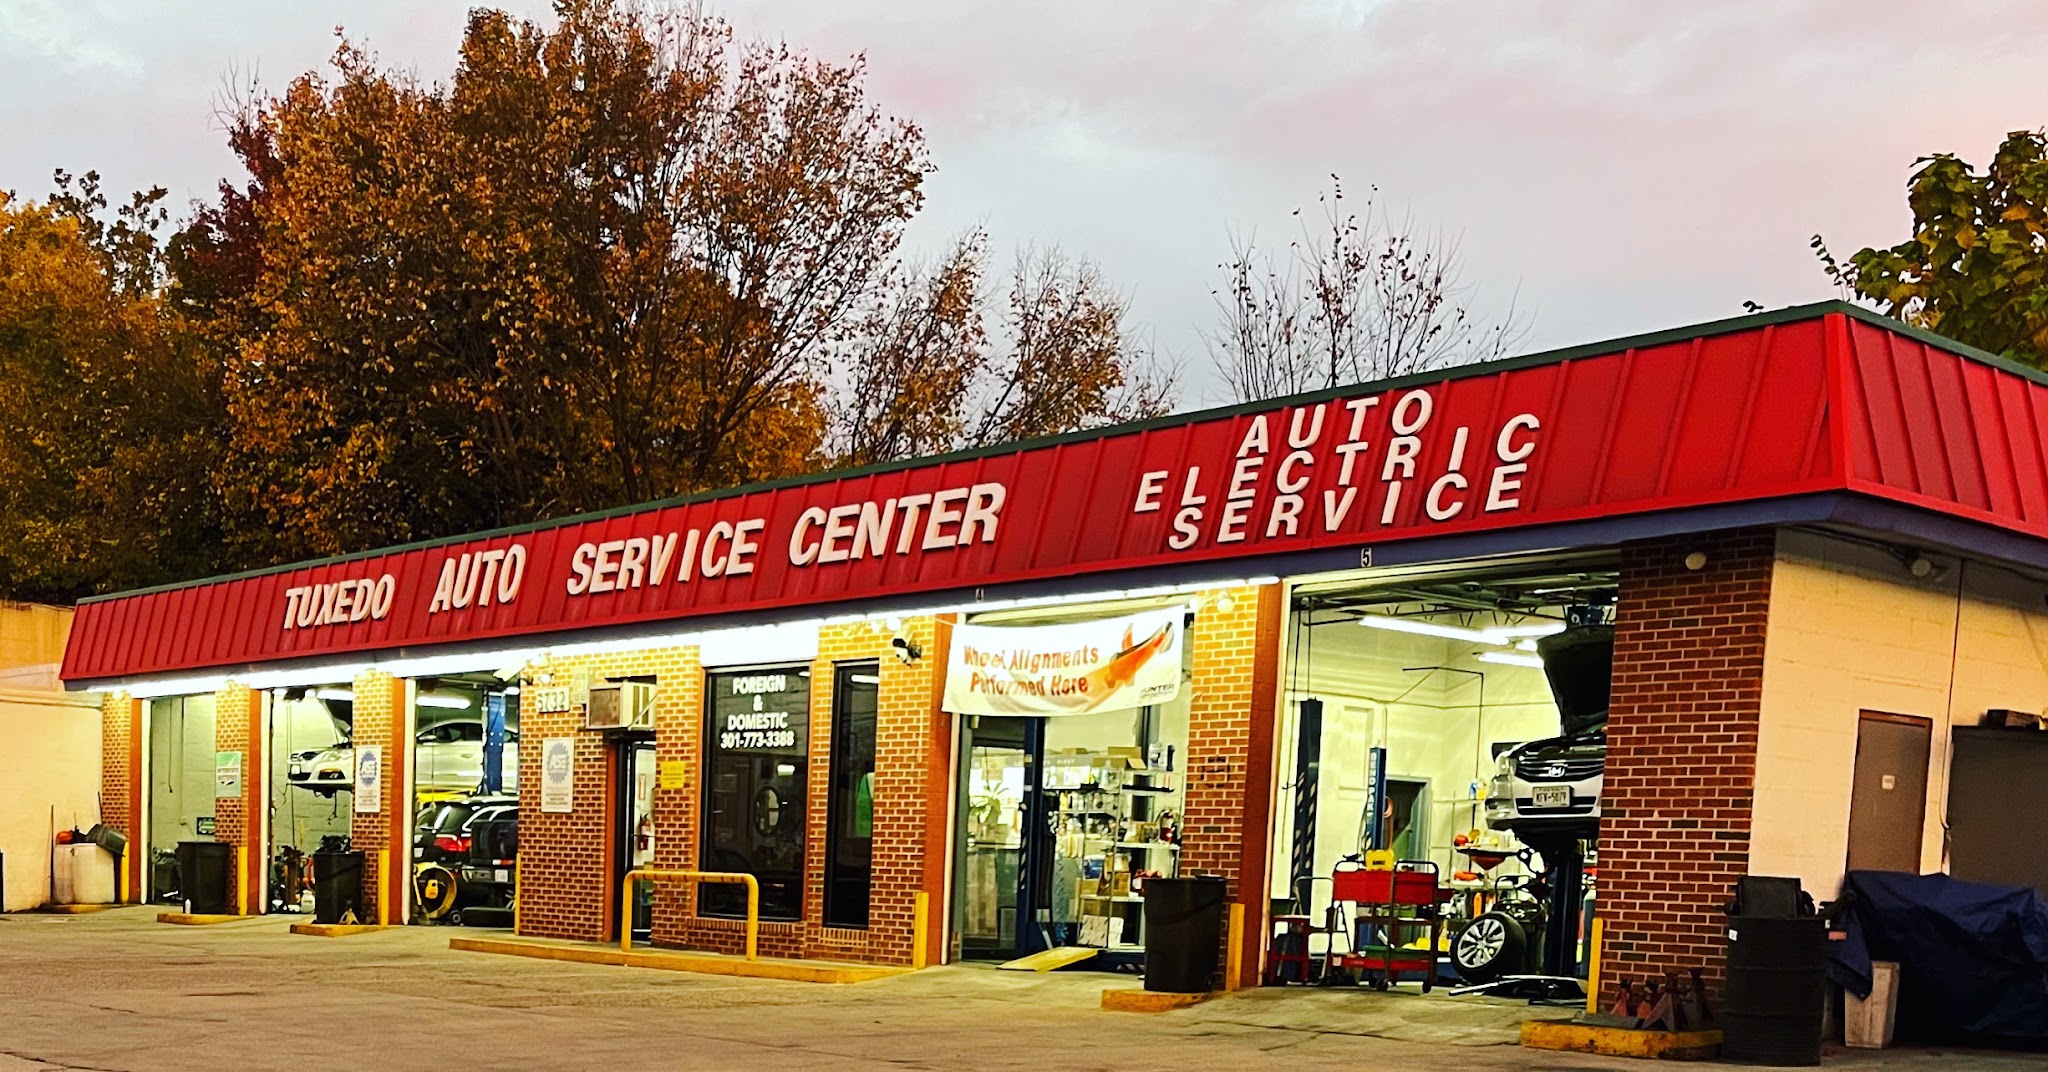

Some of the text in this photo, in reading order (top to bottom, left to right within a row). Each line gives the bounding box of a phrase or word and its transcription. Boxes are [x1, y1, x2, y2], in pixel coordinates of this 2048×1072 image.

[1235, 389, 1433, 458] AUTO
[1134, 413, 1540, 513] ELECTRIC
[1168, 463, 1528, 550] SERVICE
[283, 482, 1007, 630] TUXEDO AUTO SERVICE CENTER
[1361, 547, 1371, 567] 5
[964, 645, 1099, 674] Wheel Alignments
[732, 674, 787, 695] FOREIGN
[970, 672, 1089, 696] Performed Here
[752, 694, 764, 712] &
[727, 711, 789, 731] DOMESTIC
[720, 730, 795, 749] 301-773-3388
